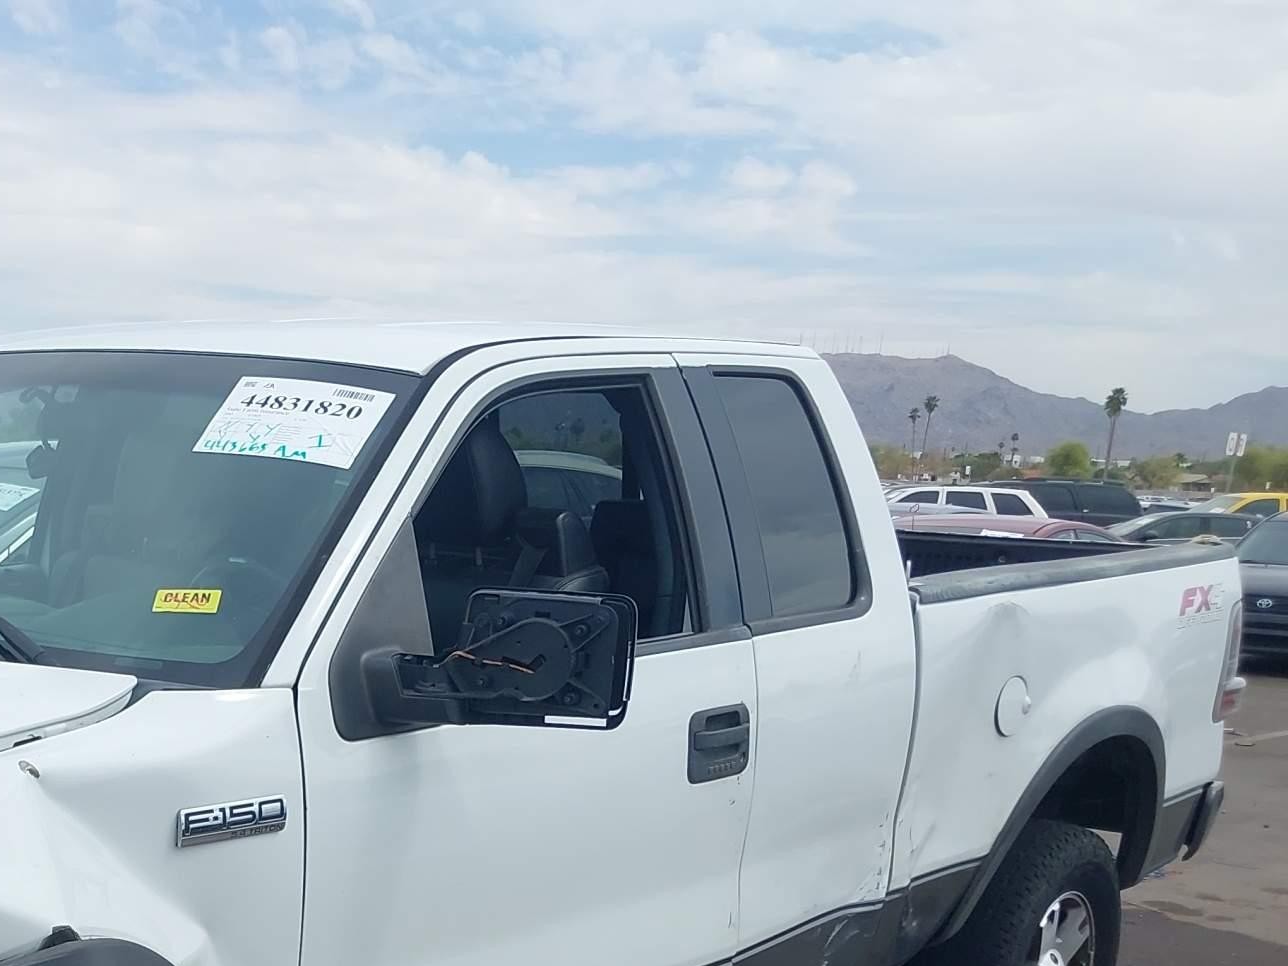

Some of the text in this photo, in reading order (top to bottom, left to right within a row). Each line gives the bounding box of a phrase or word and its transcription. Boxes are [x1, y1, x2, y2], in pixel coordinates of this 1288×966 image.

[241, 393, 364, 420] 44831820
[163, 592, 211, 604] CLEAN
[184, 797, 285, 836] F-150
